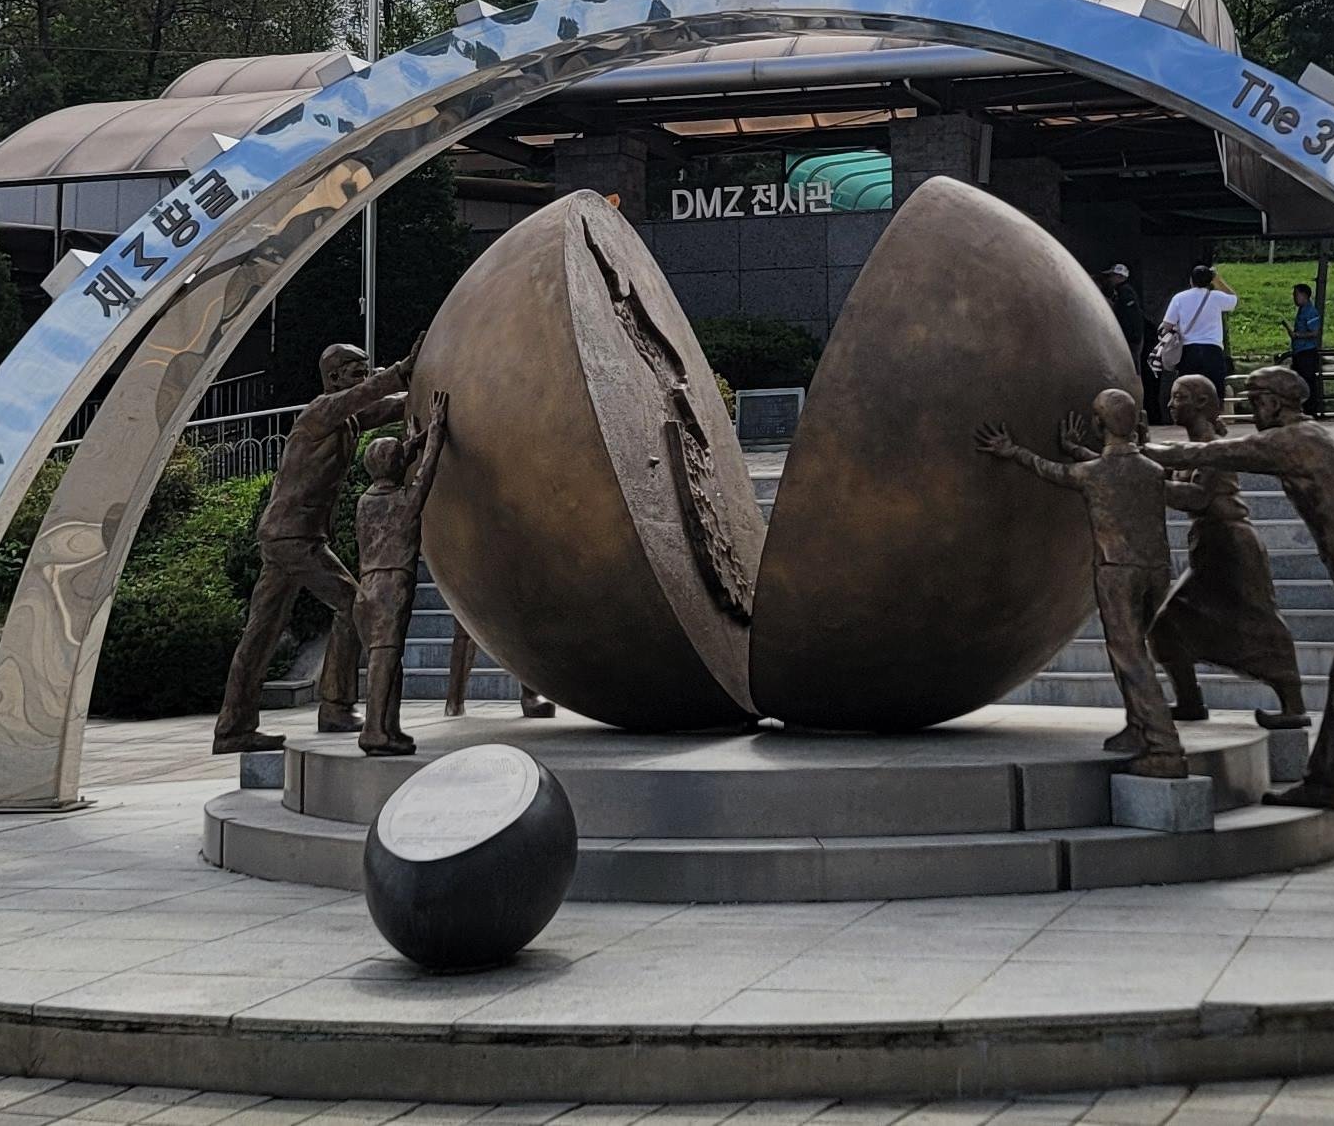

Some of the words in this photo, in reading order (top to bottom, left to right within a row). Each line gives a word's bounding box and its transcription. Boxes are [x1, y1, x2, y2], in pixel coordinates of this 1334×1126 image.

[1232, 70, 1301, 135] The
[671, 186, 745, 220] DMZ
[751, 180, 834, 215] 전시관
